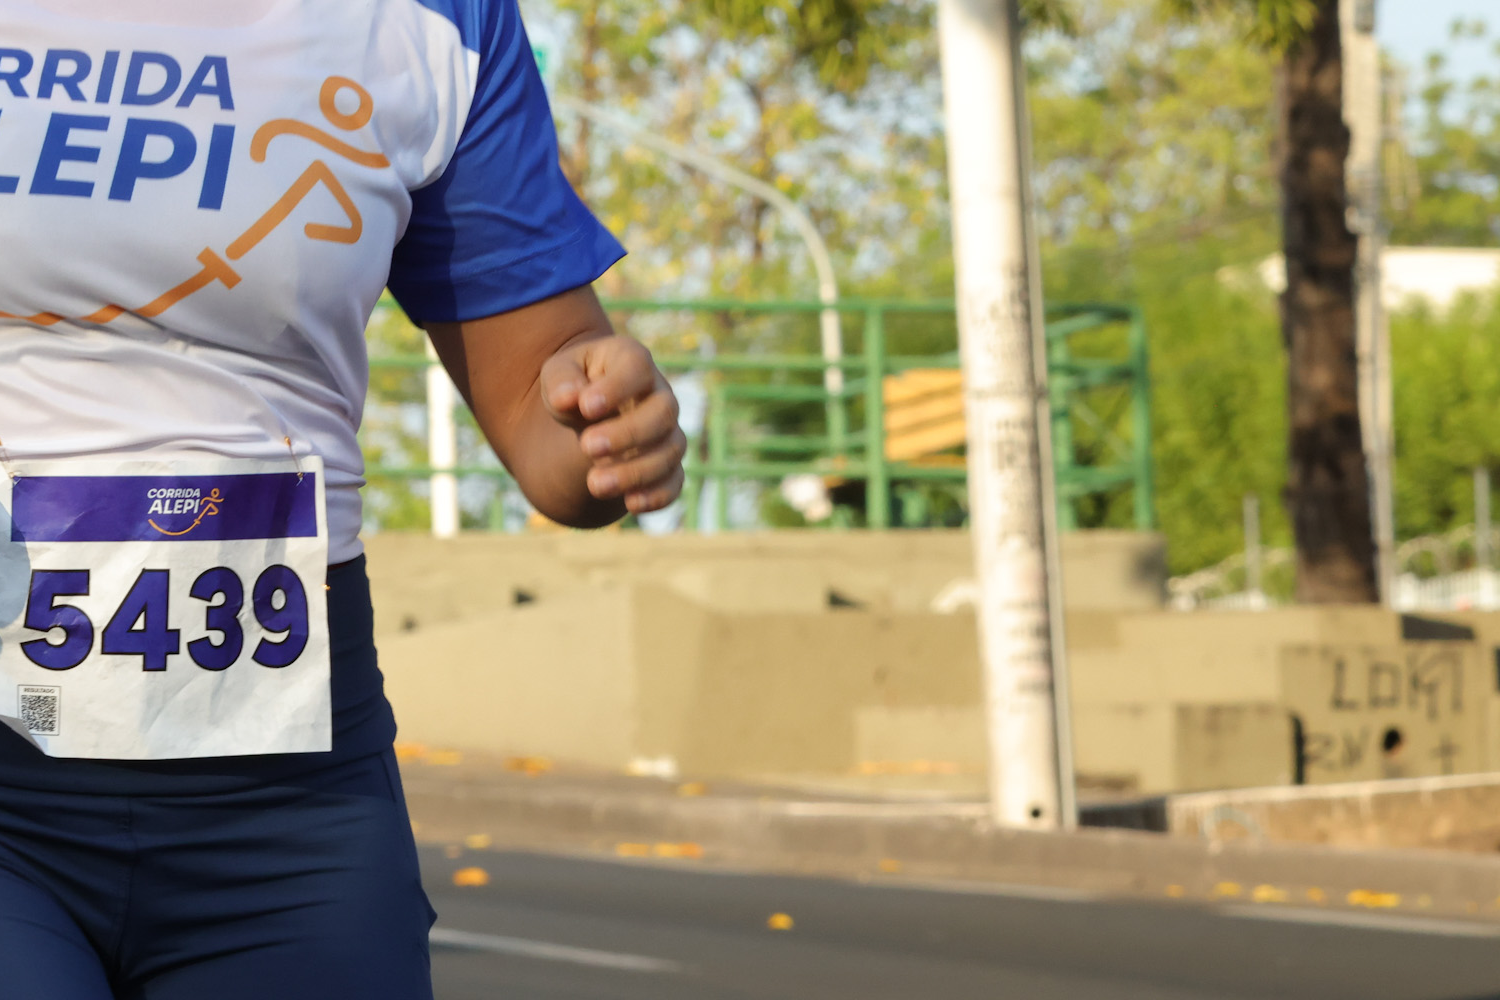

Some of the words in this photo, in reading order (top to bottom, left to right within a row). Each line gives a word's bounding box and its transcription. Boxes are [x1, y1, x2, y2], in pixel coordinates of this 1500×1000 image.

[147, 488, 201, 499] CORRIDA
[147, 499, 200, 514] ALEPI
[20, 563, 309, 672] 5439
